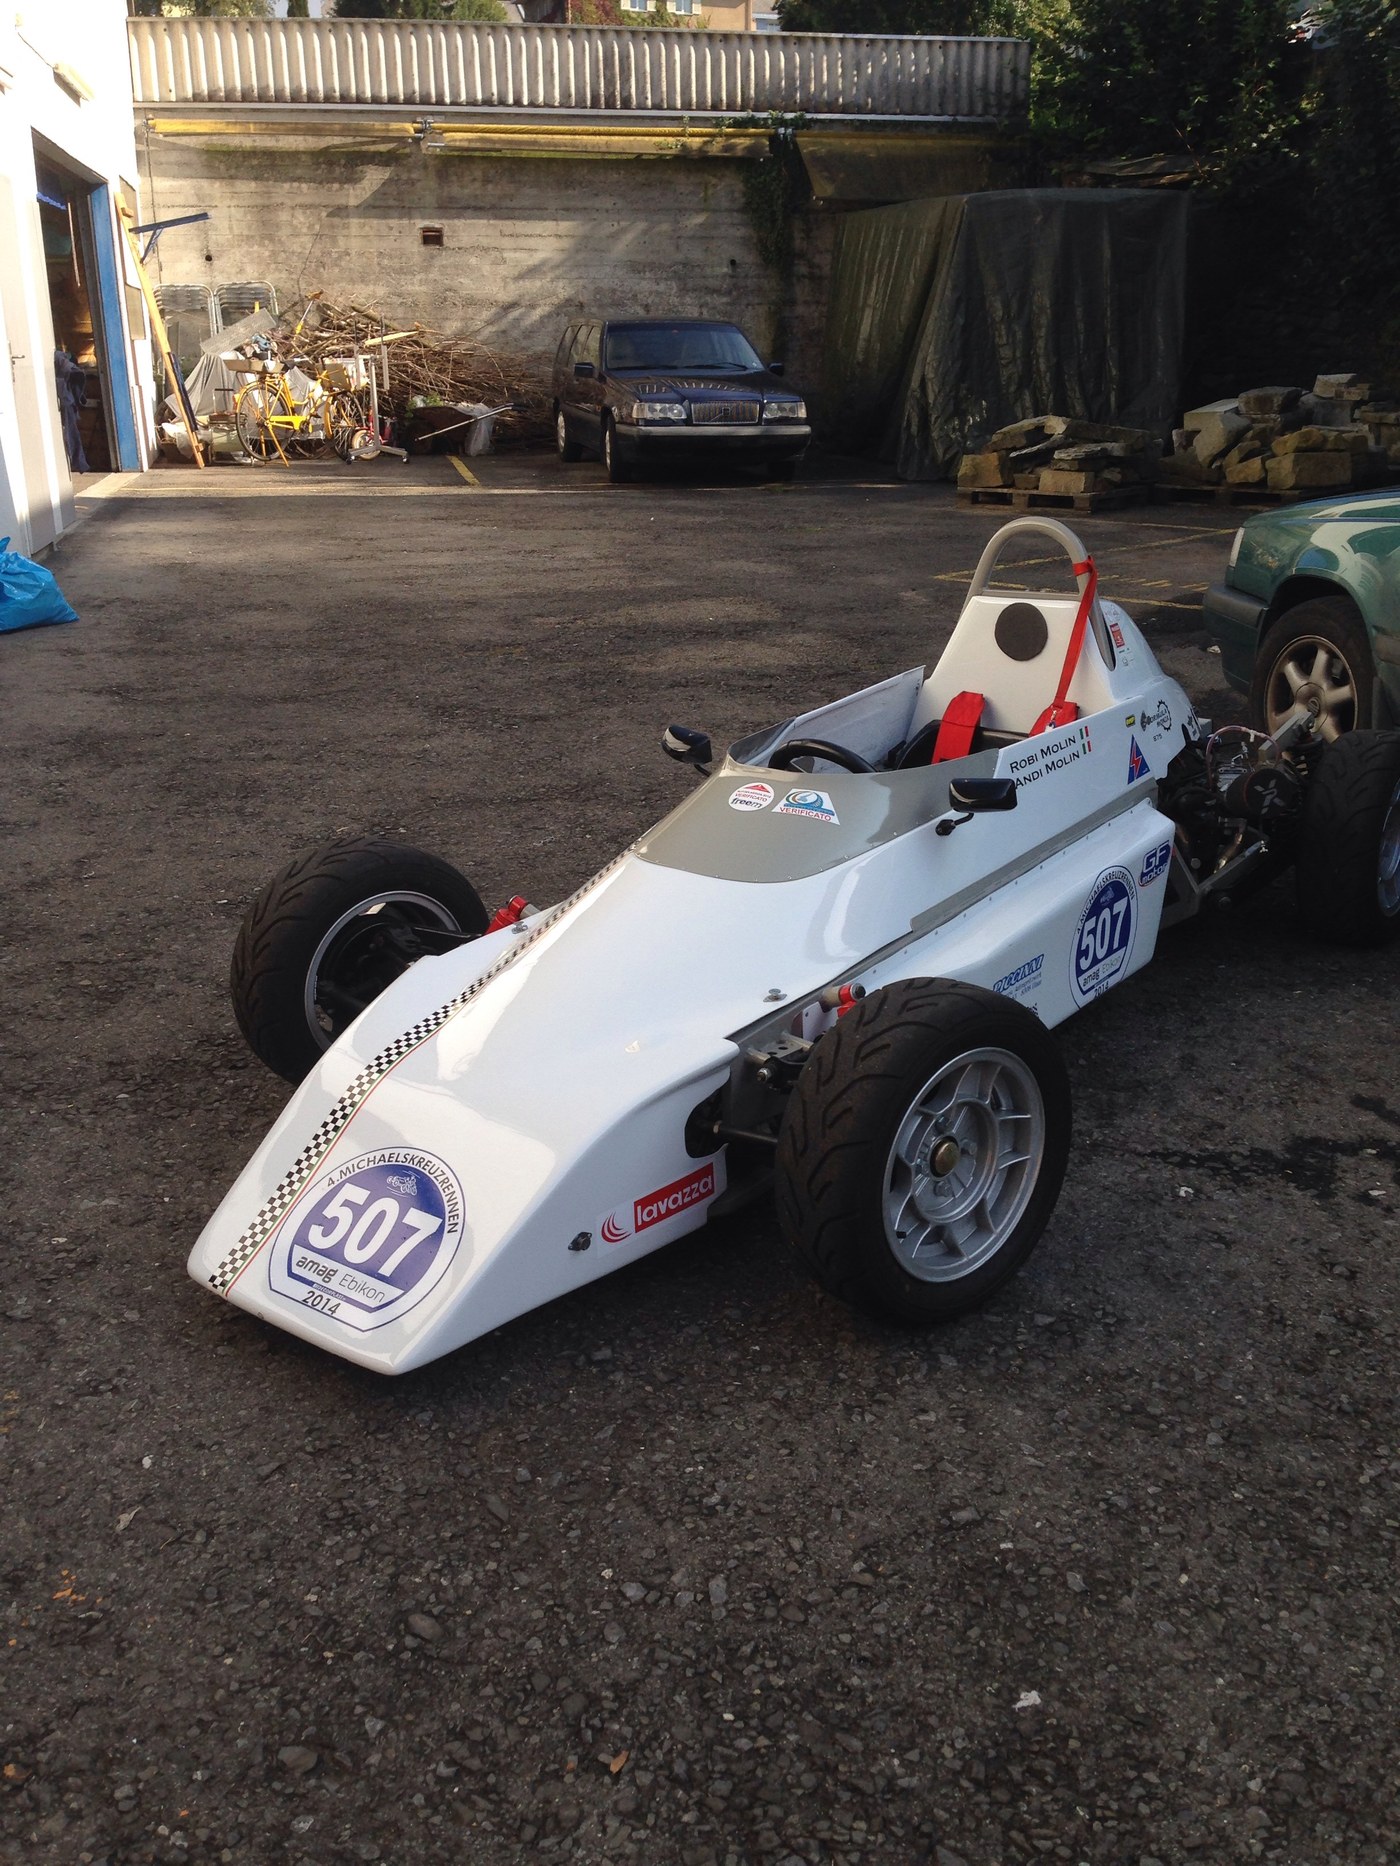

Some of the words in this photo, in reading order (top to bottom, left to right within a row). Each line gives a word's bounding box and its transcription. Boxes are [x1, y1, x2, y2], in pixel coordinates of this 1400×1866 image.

[1009, 753, 1039, 774] ROBI
[1040, 735, 1077, 759] MOLIN
[1014, 769, 1043, 790] ANDI
[1045, 750, 1080, 775] MOLIN
[730, 797, 763, 809] freem
[779, 806, 832, 822] VERIFICATO
[1142, 841, 1170, 873] GF
[1079, 896, 1129, 971] 507
[1083, 968, 1100, 987] amag
[636, 1175, 713, 1226] lavazza
[307, 1182, 444, 1278] 507
[295, 1255, 339, 1284] amag
[338, 1273, 386, 1304] Ebikon
[302, 1290, 342, 1315] 2014
